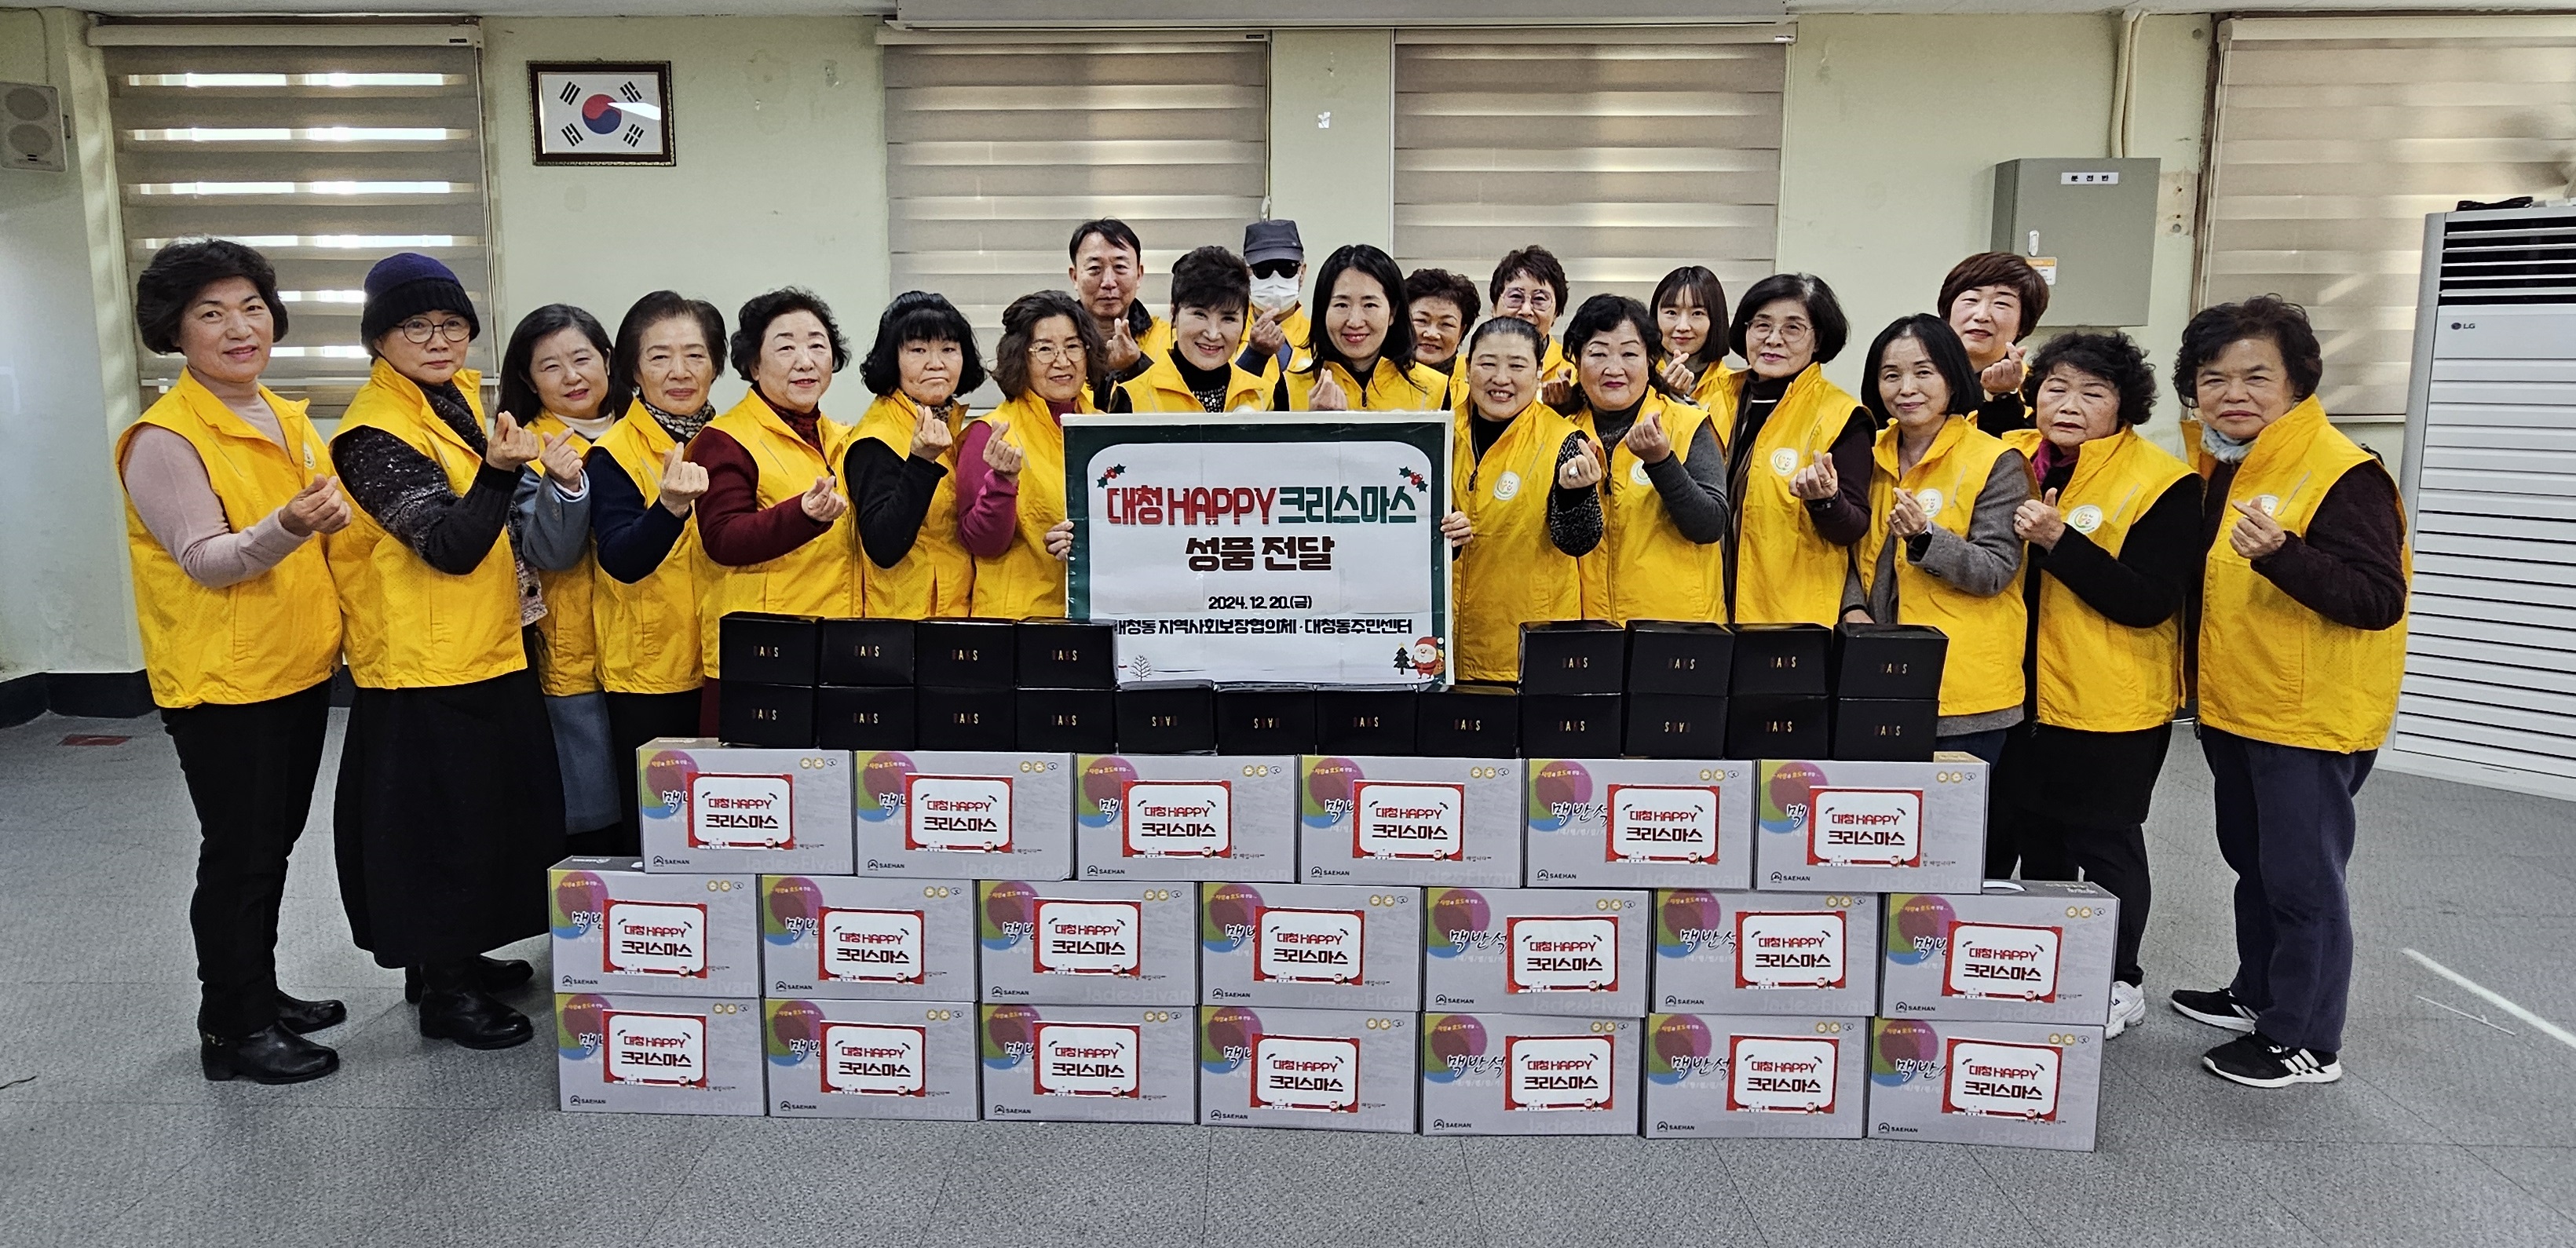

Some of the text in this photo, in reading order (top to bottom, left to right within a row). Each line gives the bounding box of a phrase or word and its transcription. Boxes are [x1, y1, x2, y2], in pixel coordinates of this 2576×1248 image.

[1107, 484, 1417, 526] 대청 HAPPY 크리스마스
[1186, 535, 1336, 572] 성품 전달
[1208, 596, 1248, 610] 2024.
[1158, 619, 1296, 635] 지역사회보장협의체
[1304, 619, 1412, 635] 대청동주민센터
[731, 799, 772, 809] HAPPY
[950, 801, 992, 812] HAPPY
[1168, 808, 1210, 817] HAPPY
[1400, 808, 1442, 819] HAPPY
[1654, 812, 1697, 822] HAPPY
[706, 814, 778, 829] 크리스마스
[924, 817, 997, 832] 크리스마스
[1856, 815, 1899, 825] HAPPY
[1142, 823, 1216, 837] 크리스마스
[1372, 824, 1448, 840] 크리스마스
[1626, 827, 1703, 842] 크리스마스
[1828, 830, 1905, 845] 크리스마스
[646, 927, 686, 937] HAPPY
[1078, 925, 1120, 936] HAPPY
[862, 934, 903, 944] HAPPY
[1300, 934, 1343, 945] HAPPY
[1782, 938, 1825, 947] HAPPY
[621, 941, 692, 957] 크리스마스
[1052, 940, 1125, 955] 크리스마스
[1554, 942, 1596, 951] HAPPY
[837, 948, 909, 964] 크리스마스
[1273, 948, 1348, 965] 크리스마스
[1755, 954, 1831, 968] 크리스마스
[1993, 950, 2037, 962] HAPPY
[1527, 958, 1602, 971] 크리스마스
[1964, 964, 2041, 981] 크리스마스
[646, 1038, 685, 1048] HAPPY
[621, 1051, 692, 1067] 크리스마스
[864, 1048, 904, 1059] HAPPY
[1078, 1049, 1119, 1059] HAPPY
[839, 1062, 911, 1077] 크리스마스
[1052, 1063, 1124, 1078] 크리스마스
[1296, 1062, 1338, 1072] HAPPY
[1551, 1060, 1592, 1071] HAPPY
[1774, 1062, 1817, 1073] HAPPY
[1896, 1060, 1945, 1082] 맥반
[1993, 1067, 2038, 1080] HAPPY
[1270, 1075, 1343, 1092] 크리스마스
[1524, 1075, 1598, 1089] 크리스마스
[1747, 1078, 1821, 1093] 크리스마스
[1964, 1081, 2042, 1100] 크리스마스
